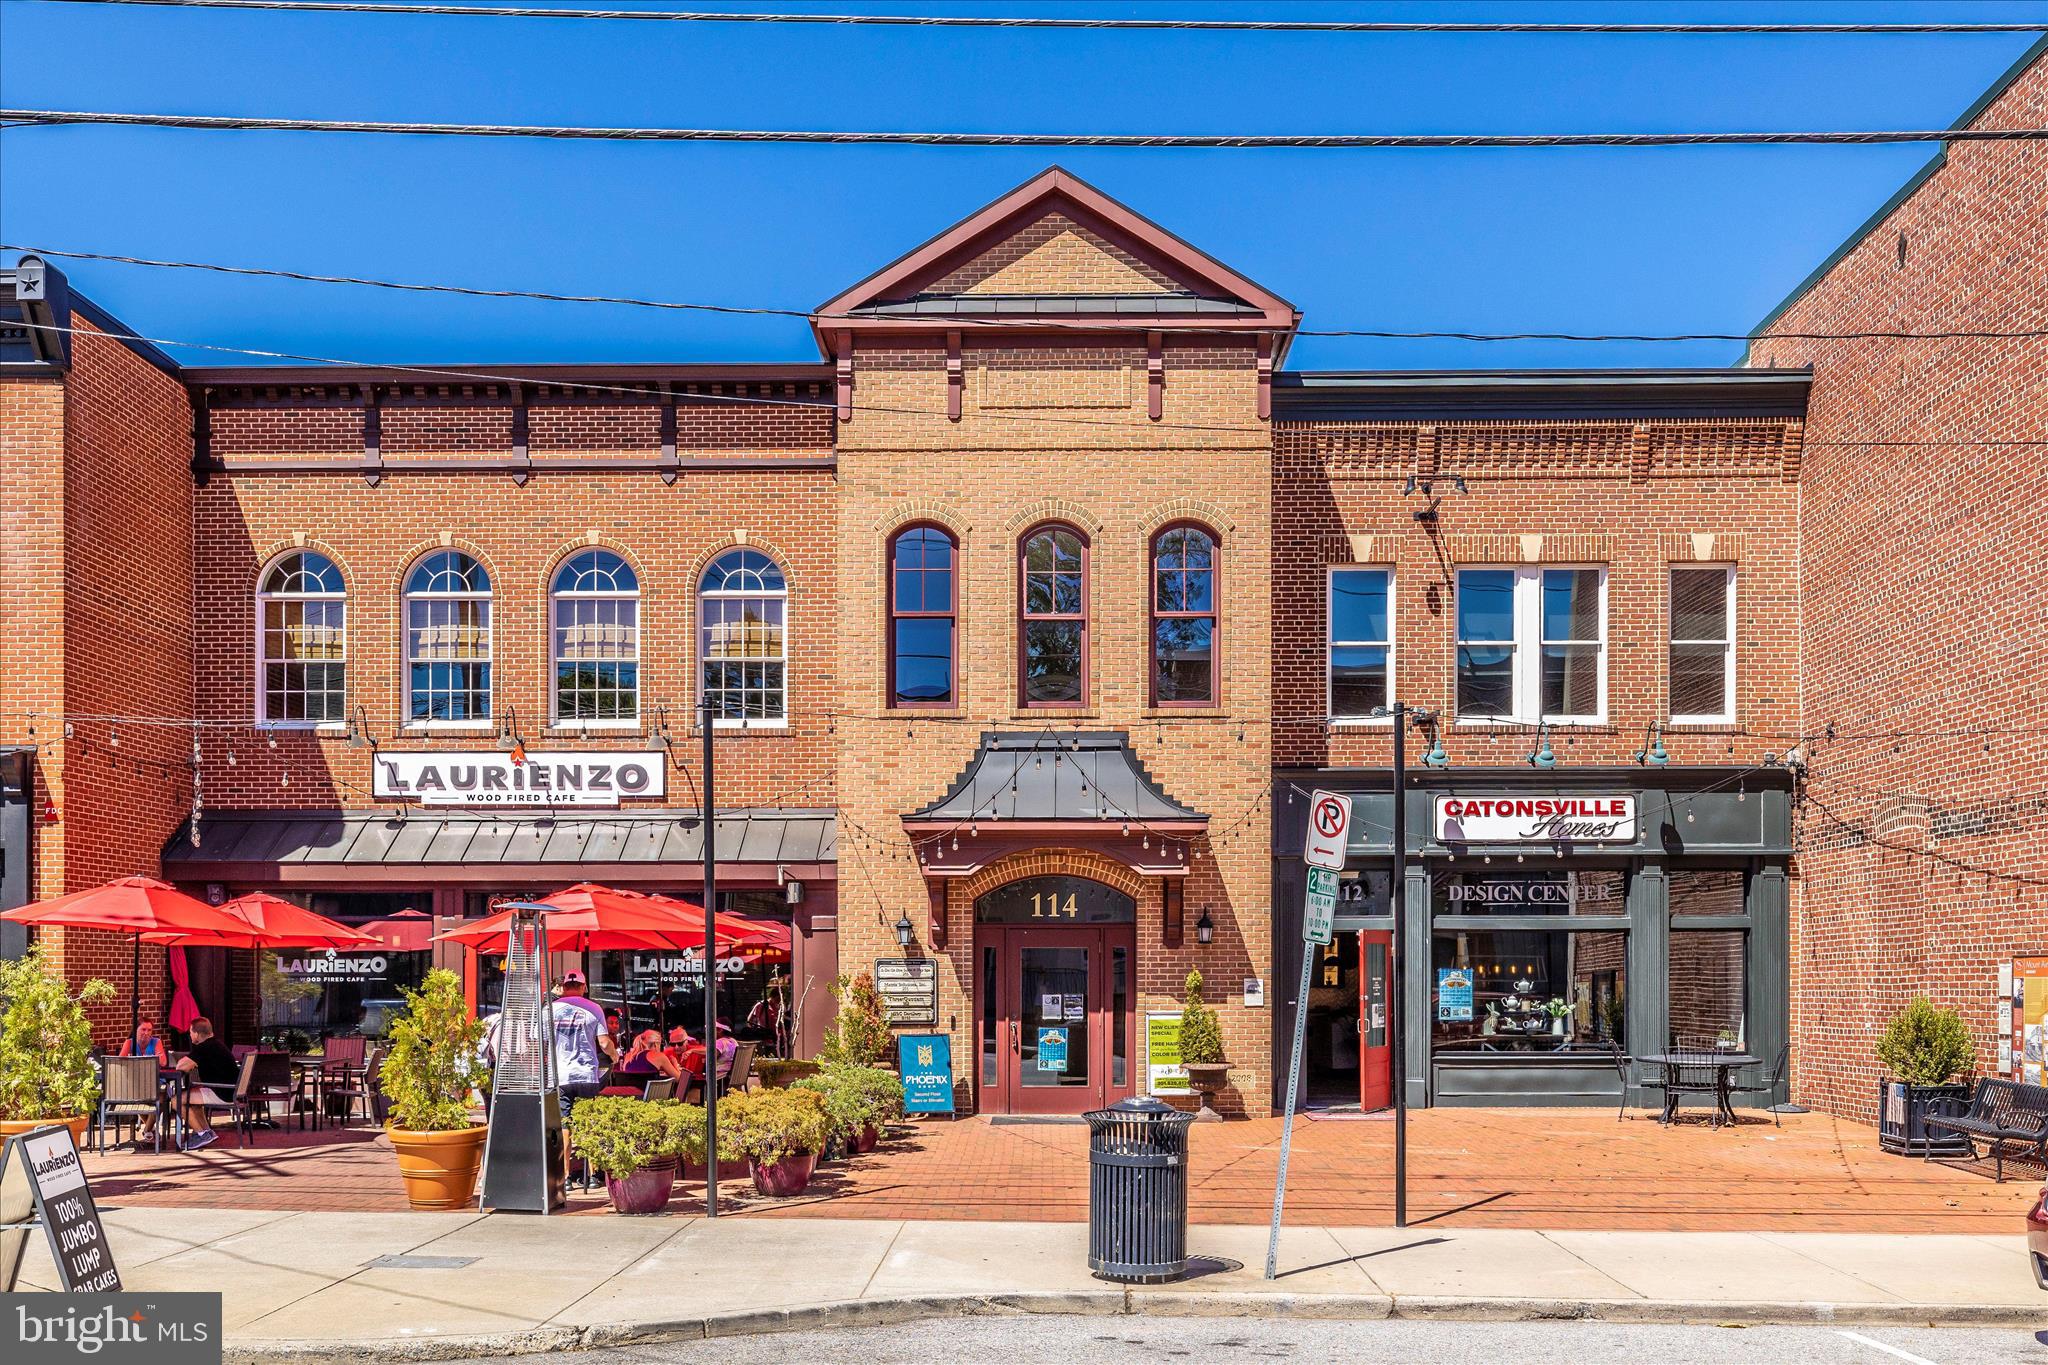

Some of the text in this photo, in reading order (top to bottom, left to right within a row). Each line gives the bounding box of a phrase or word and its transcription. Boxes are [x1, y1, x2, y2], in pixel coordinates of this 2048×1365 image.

[466, 794, 576, 802] WOOD FIRED CAFE
[1444, 800, 1627, 817] CATONSVILLE
[1519, 812, 1621, 838] Homes
[1309, 871, 1318, 890] 2
[1317, 882, 1336, 895] PARKING
[1448, 885, 1610, 901] DESIGN CENTER
[1030, 892, 1079, 918] 114
[1323, 898, 1331, 907] AM
[1316, 907, 1323, 917] TO
[1321, 920, 1329, 929] PM
[905, 1075, 948, 1085] PHOENIX
[54, 1196, 85, 1224] 100%
[60, 1219, 97, 1253] JUMBO
[72, 1247, 101, 1278] LUMP
[93, 1268, 118, 1292] CAKES
